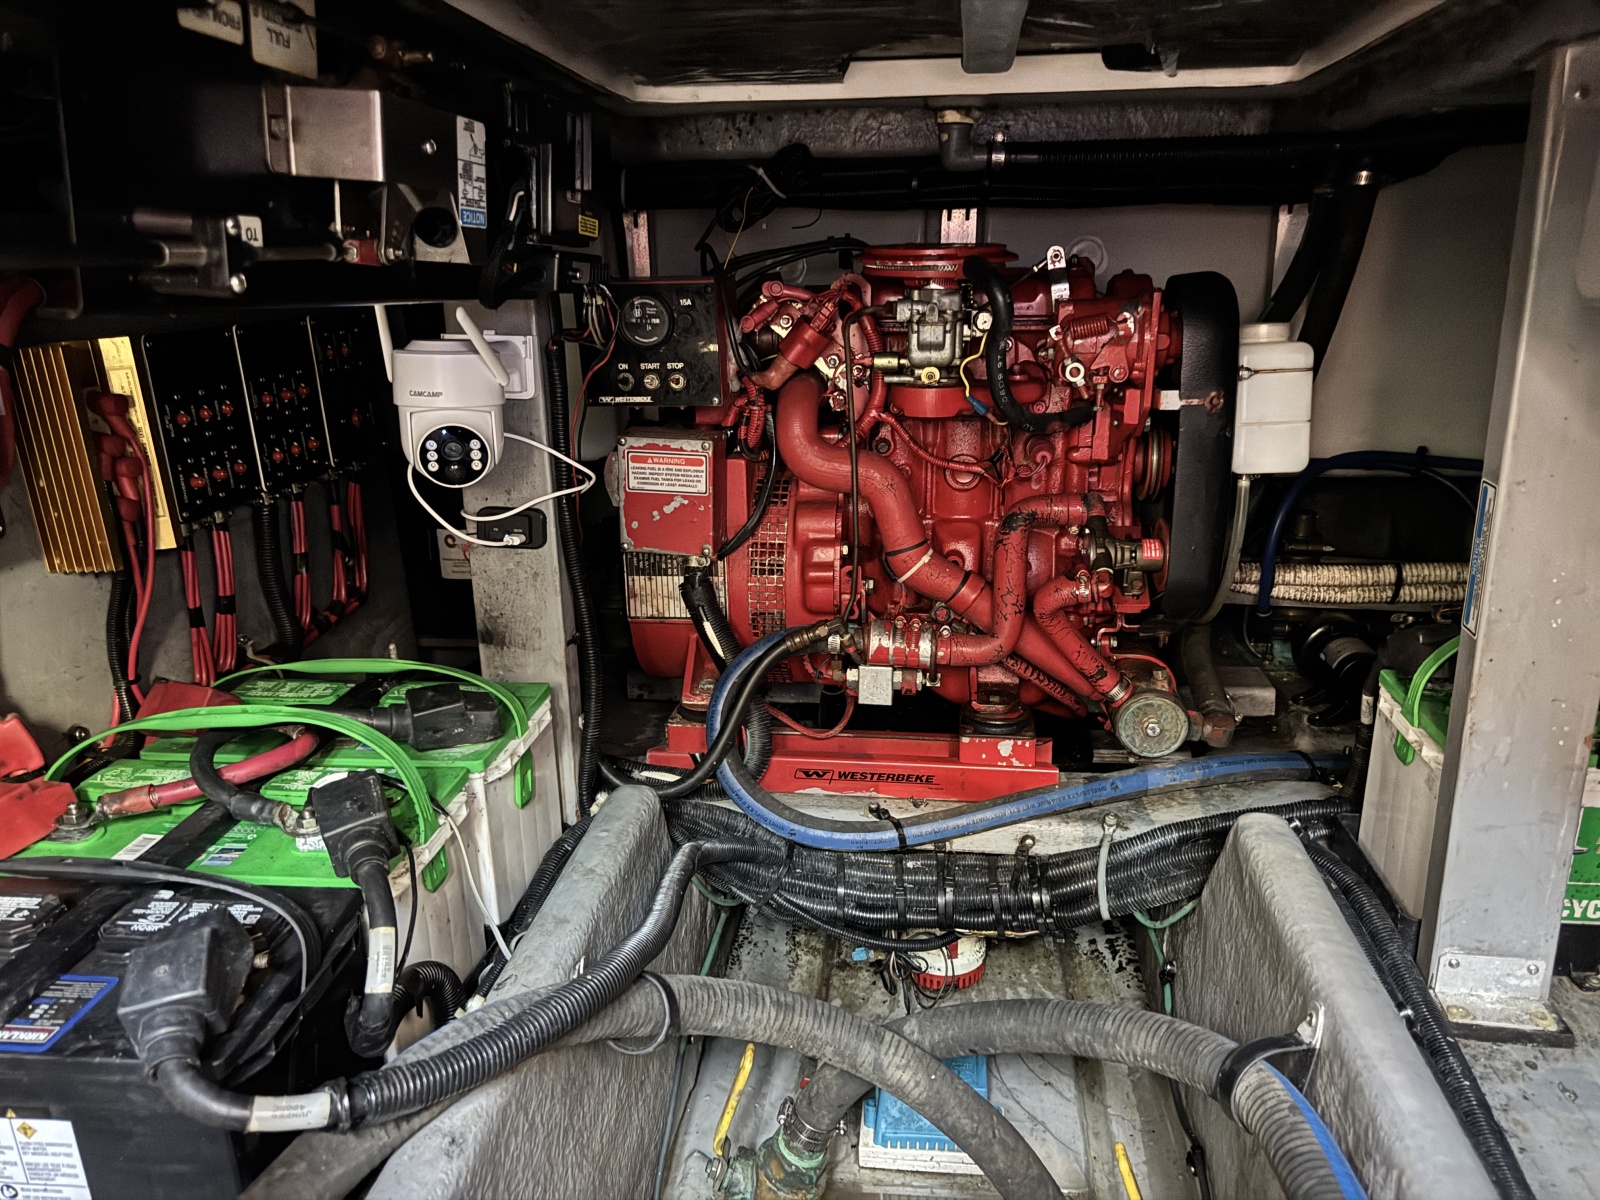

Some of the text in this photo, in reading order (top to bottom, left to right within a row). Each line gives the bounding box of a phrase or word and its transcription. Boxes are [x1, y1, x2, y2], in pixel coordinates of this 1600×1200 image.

[211, 10, 241, 31] FROM
[266, 27, 291, 49] FULL
[462, 210, 485, 225] NOTICE
[245, 227, 259, 242] TO
[640, 362, 661, 370] START
[666, 362, 685, 370] STOP
[409, 390, 443, 398] CAMCAMP
[1471, 537, 1481, 576] NOTICE
[837, 771, 936, 783] WESTERBEKE
[1021, 803, 1036, 812] WET
[1036, 796, 1062, 808] MARINE
